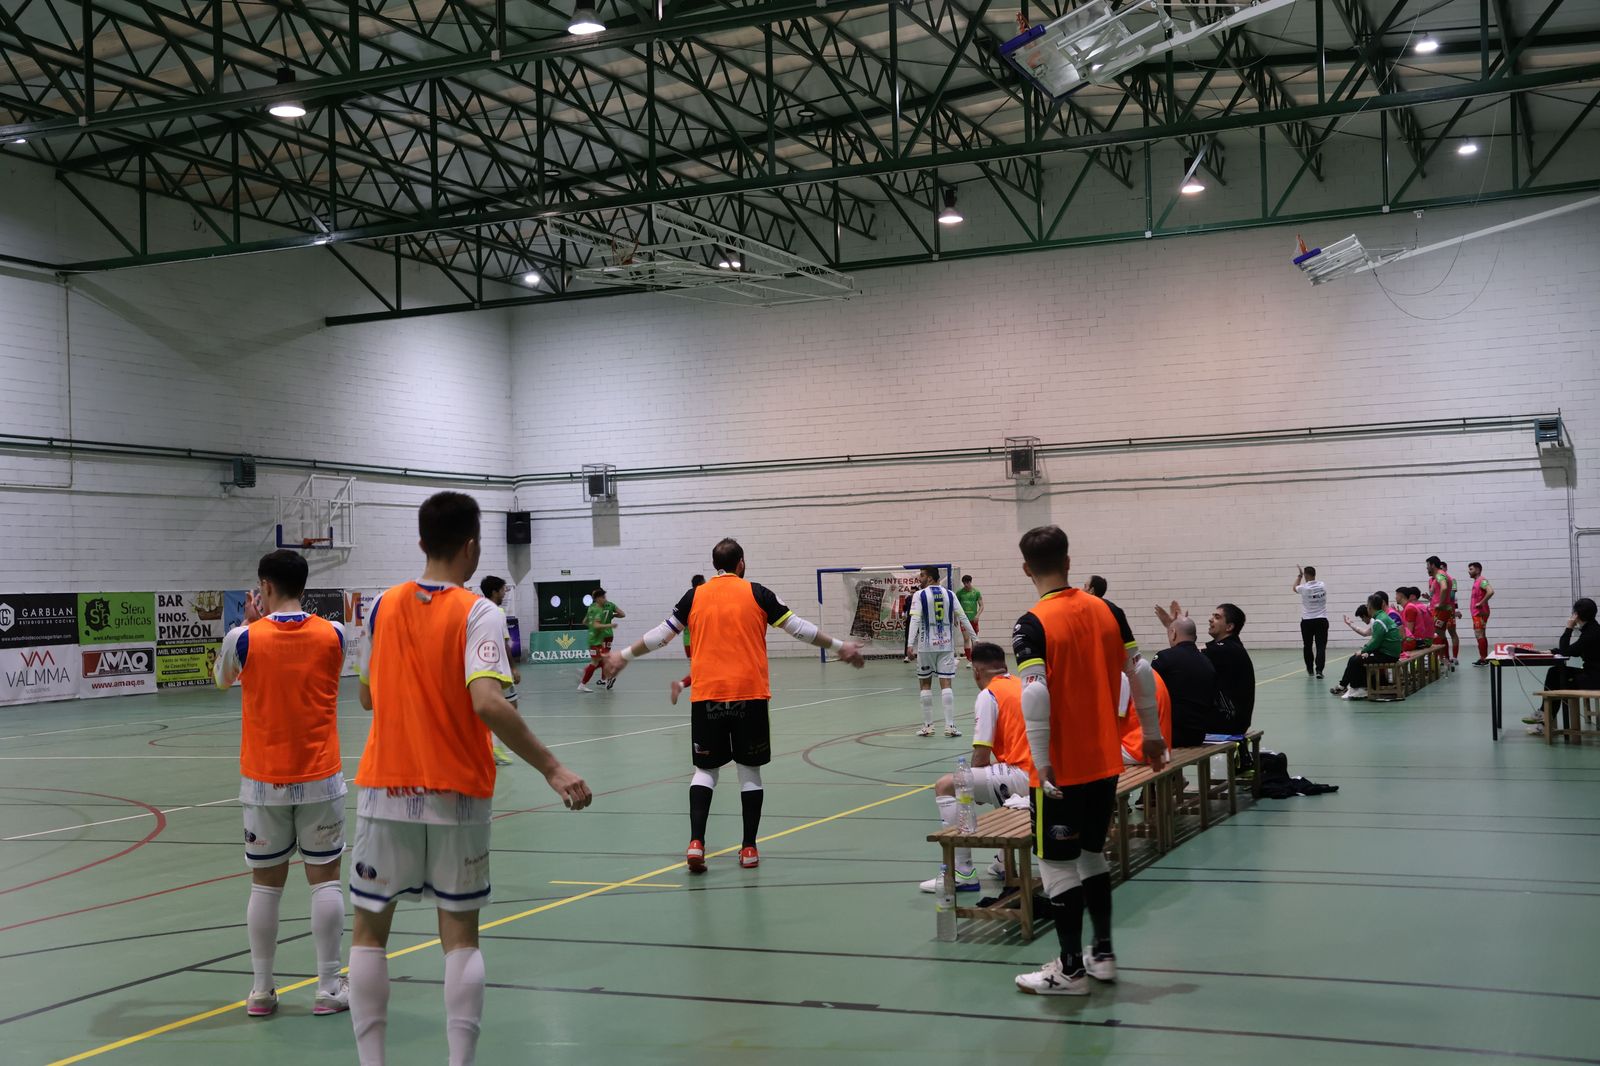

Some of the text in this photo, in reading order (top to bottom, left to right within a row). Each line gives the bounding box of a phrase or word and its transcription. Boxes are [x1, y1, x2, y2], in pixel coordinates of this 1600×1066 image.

[121, 601, 145, 615] Sfera
[158, 594, 184, 608] BAR
[22, 608, 73, 617] GARBLAN
[158, 612, 189, 623] HNOS.
[603, 610, 609, 623] 7
[934, 602, 944, 621] 5
[158, 621, 212, 640] PINZÓN
[531, 649, 592, 660] CAJA RURA
[86, 651, 149, 676] AMAQ
[5, 667, 71, 688] VALMMA
[91, 680, 145, 689] www.amaq.es
